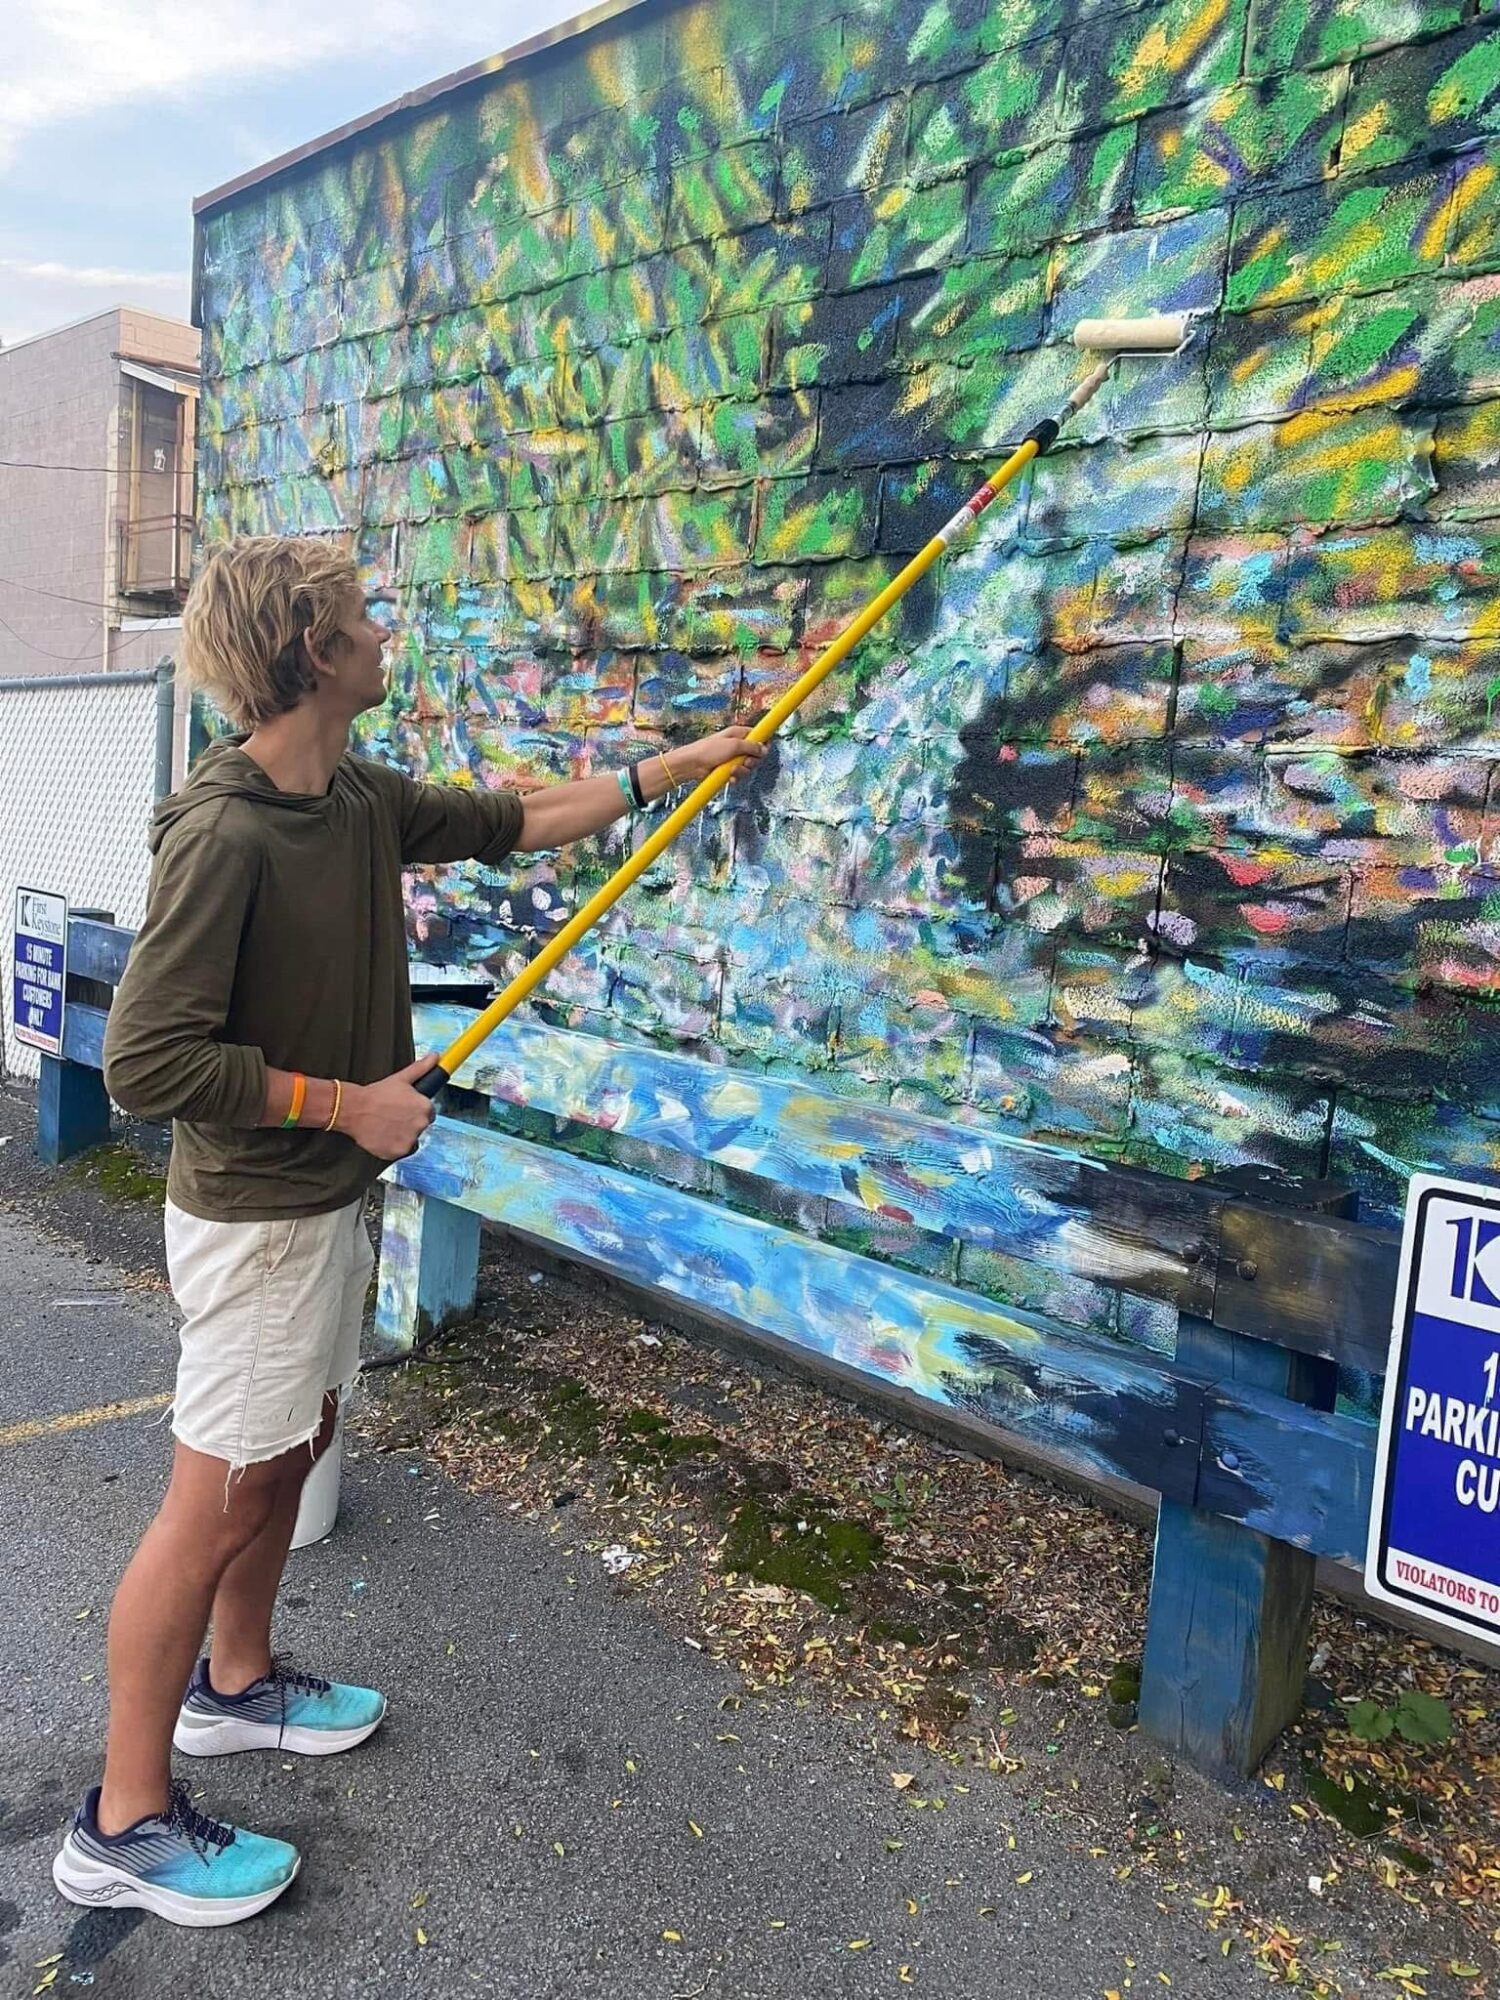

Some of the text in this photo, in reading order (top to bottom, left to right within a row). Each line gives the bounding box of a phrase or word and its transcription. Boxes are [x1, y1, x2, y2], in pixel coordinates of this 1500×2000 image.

[31, 912, 62, 936] Keystone
[1405, 1386, 1500, 1459] PARKI
[1455, 1459, 1500, 1513] CU
[1396, 1560, 1499, 1613] VIOLATORS TO
